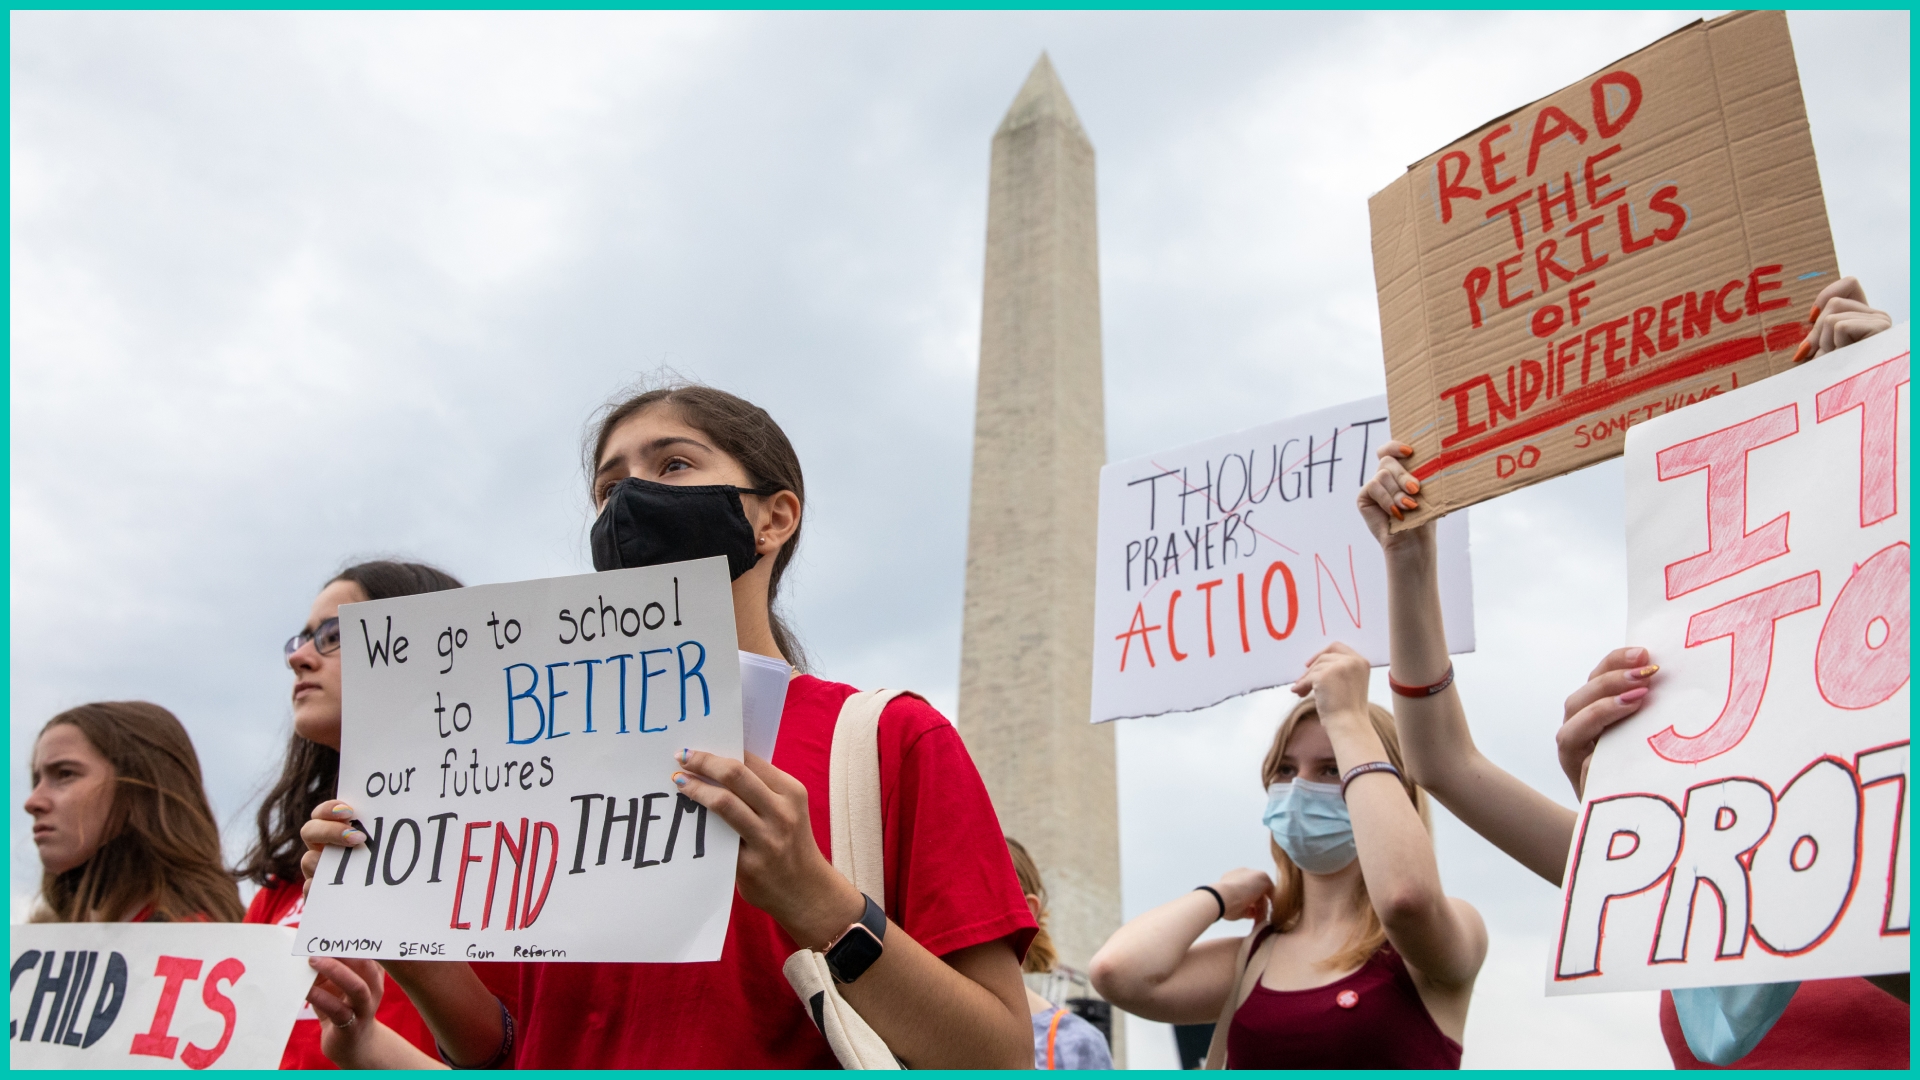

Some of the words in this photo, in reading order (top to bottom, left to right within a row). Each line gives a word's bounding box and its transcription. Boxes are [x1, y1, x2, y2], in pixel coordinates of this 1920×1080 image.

[1436, 70, 1643, 224] READ
[1486, 143, 1627, 251] THE
[1462, 185, 1687, 329] PERILS
[1530, 280, 1596, 338] OF
[1496, 444, 1541, 479] DO
[1126, 510, 1257, 591] PRAYERS
[360, 615, 409, 668] We
[437, 626, 468, 674] go
[487, 611, 521, 649] to
[558, 577, 682, 644] school
[1115, 544, 1361, 672] ACTION
[434, 692, 472, 738] to
[503, 640, 711, 745] BETTER
[366, 767, 416, 798] our
[440, 748, 554, 798] futures
[328, 812, 458, 887] NOT
[450, 817, 559, 931] END
[568, 792, 707, 875] THEM
[307, 936, 383, 953] COMMON
[399, 942, 447, 957] SENSE
[466, 944, 495, 959] Gun
[513, 945, 567, 959] Reform
[10, 949, 129, 1049] CHILD
[129, 955, 246, 1070] IS
